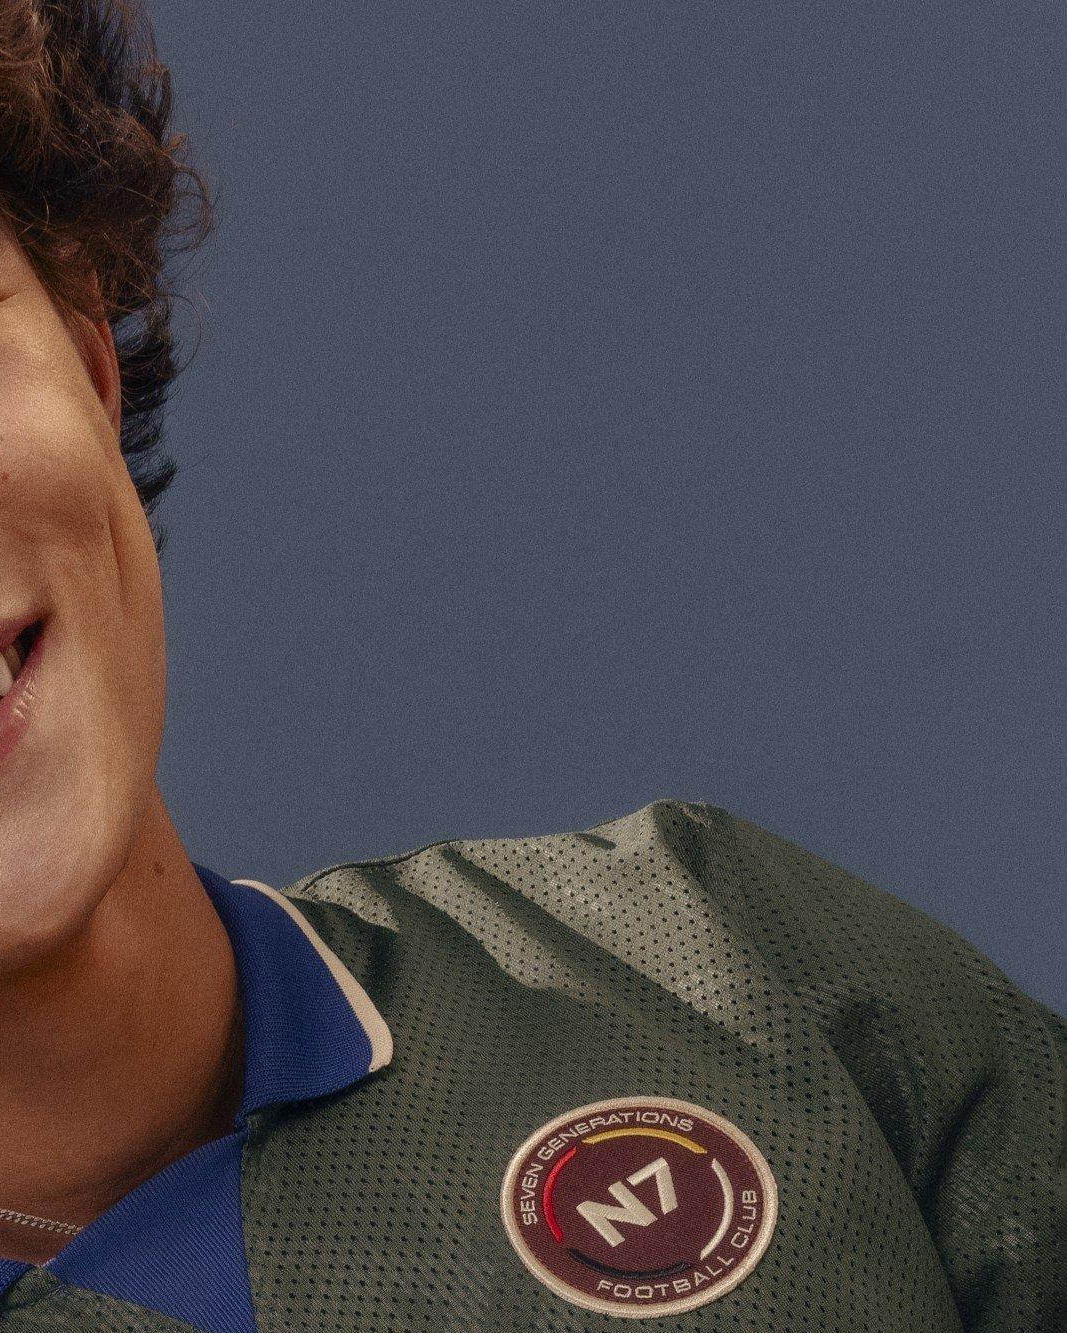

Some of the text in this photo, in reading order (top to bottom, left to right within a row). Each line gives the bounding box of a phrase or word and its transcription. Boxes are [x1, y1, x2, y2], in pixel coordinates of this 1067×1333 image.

[520, 1111, 694, 1226] SEVEN GENERATIONS
[576, 1156, 679, 1248] N7
[596, 1189, 758, 1299] FOOTBALL CLUB
